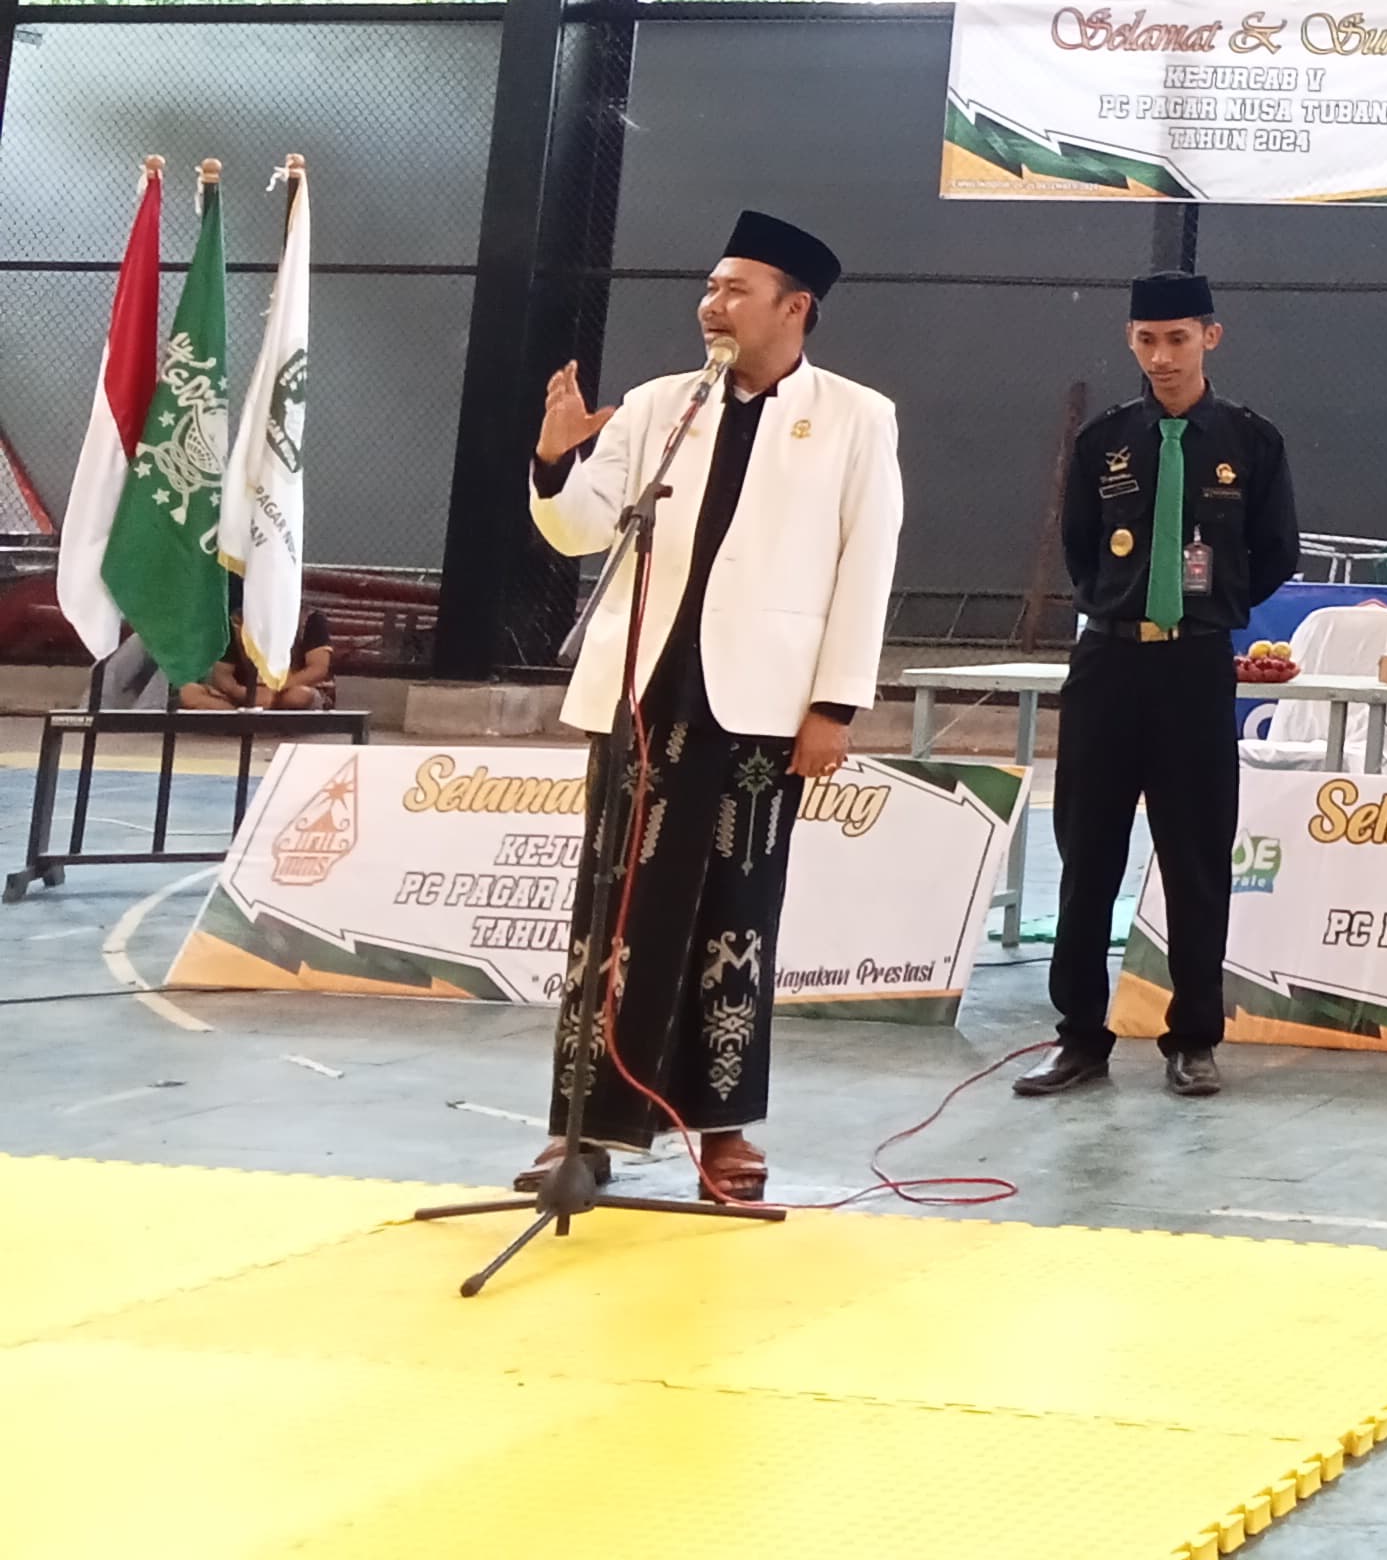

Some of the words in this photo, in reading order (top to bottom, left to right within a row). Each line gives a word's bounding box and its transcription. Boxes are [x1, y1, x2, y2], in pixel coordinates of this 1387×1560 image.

[1052, 5, 1223, 55] Selamat
[1228, 11, 1287, 55] &
[1164, 64, 1299, 90] KEJURCAB
[1306, 68, 1326, 93] V
[1099, 95, 1130, 119] PC
[1136, 95, 1217, 121] PAGAR
[1224, 97, 1294, 122] NUSA
[1168, 126, 1249, 151] TAHUN
[1253, 128, 1311, 153] 2024
[394, 871, 444, 904] PC
[444, 874, 558, 910] PAGAR
[1323, 909, 1373, 947] PC
[856, 957, 936, 985] Prestasi
